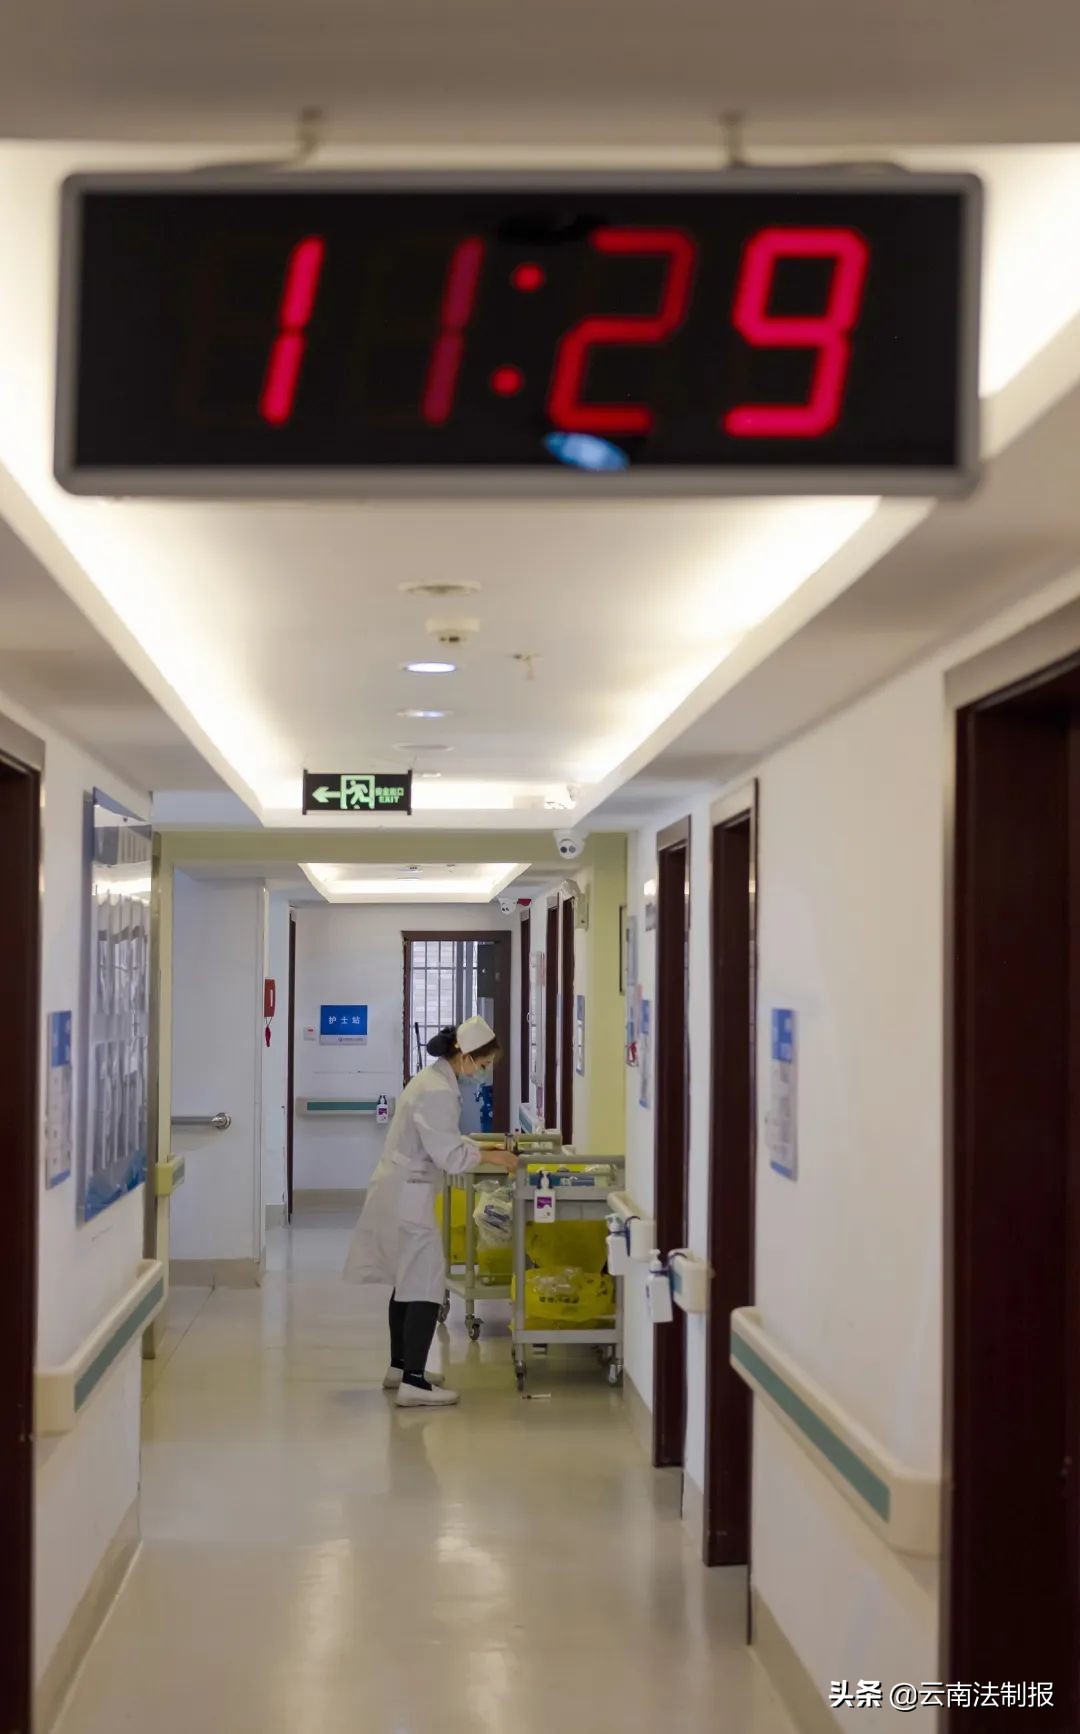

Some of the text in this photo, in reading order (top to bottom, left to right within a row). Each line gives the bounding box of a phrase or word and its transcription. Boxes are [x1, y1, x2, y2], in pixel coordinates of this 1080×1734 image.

[260, 228, 868, 437] 11:29
[379, 795, 399, 803] EXIT
[328, 1016, 360, 1024] 护士站
